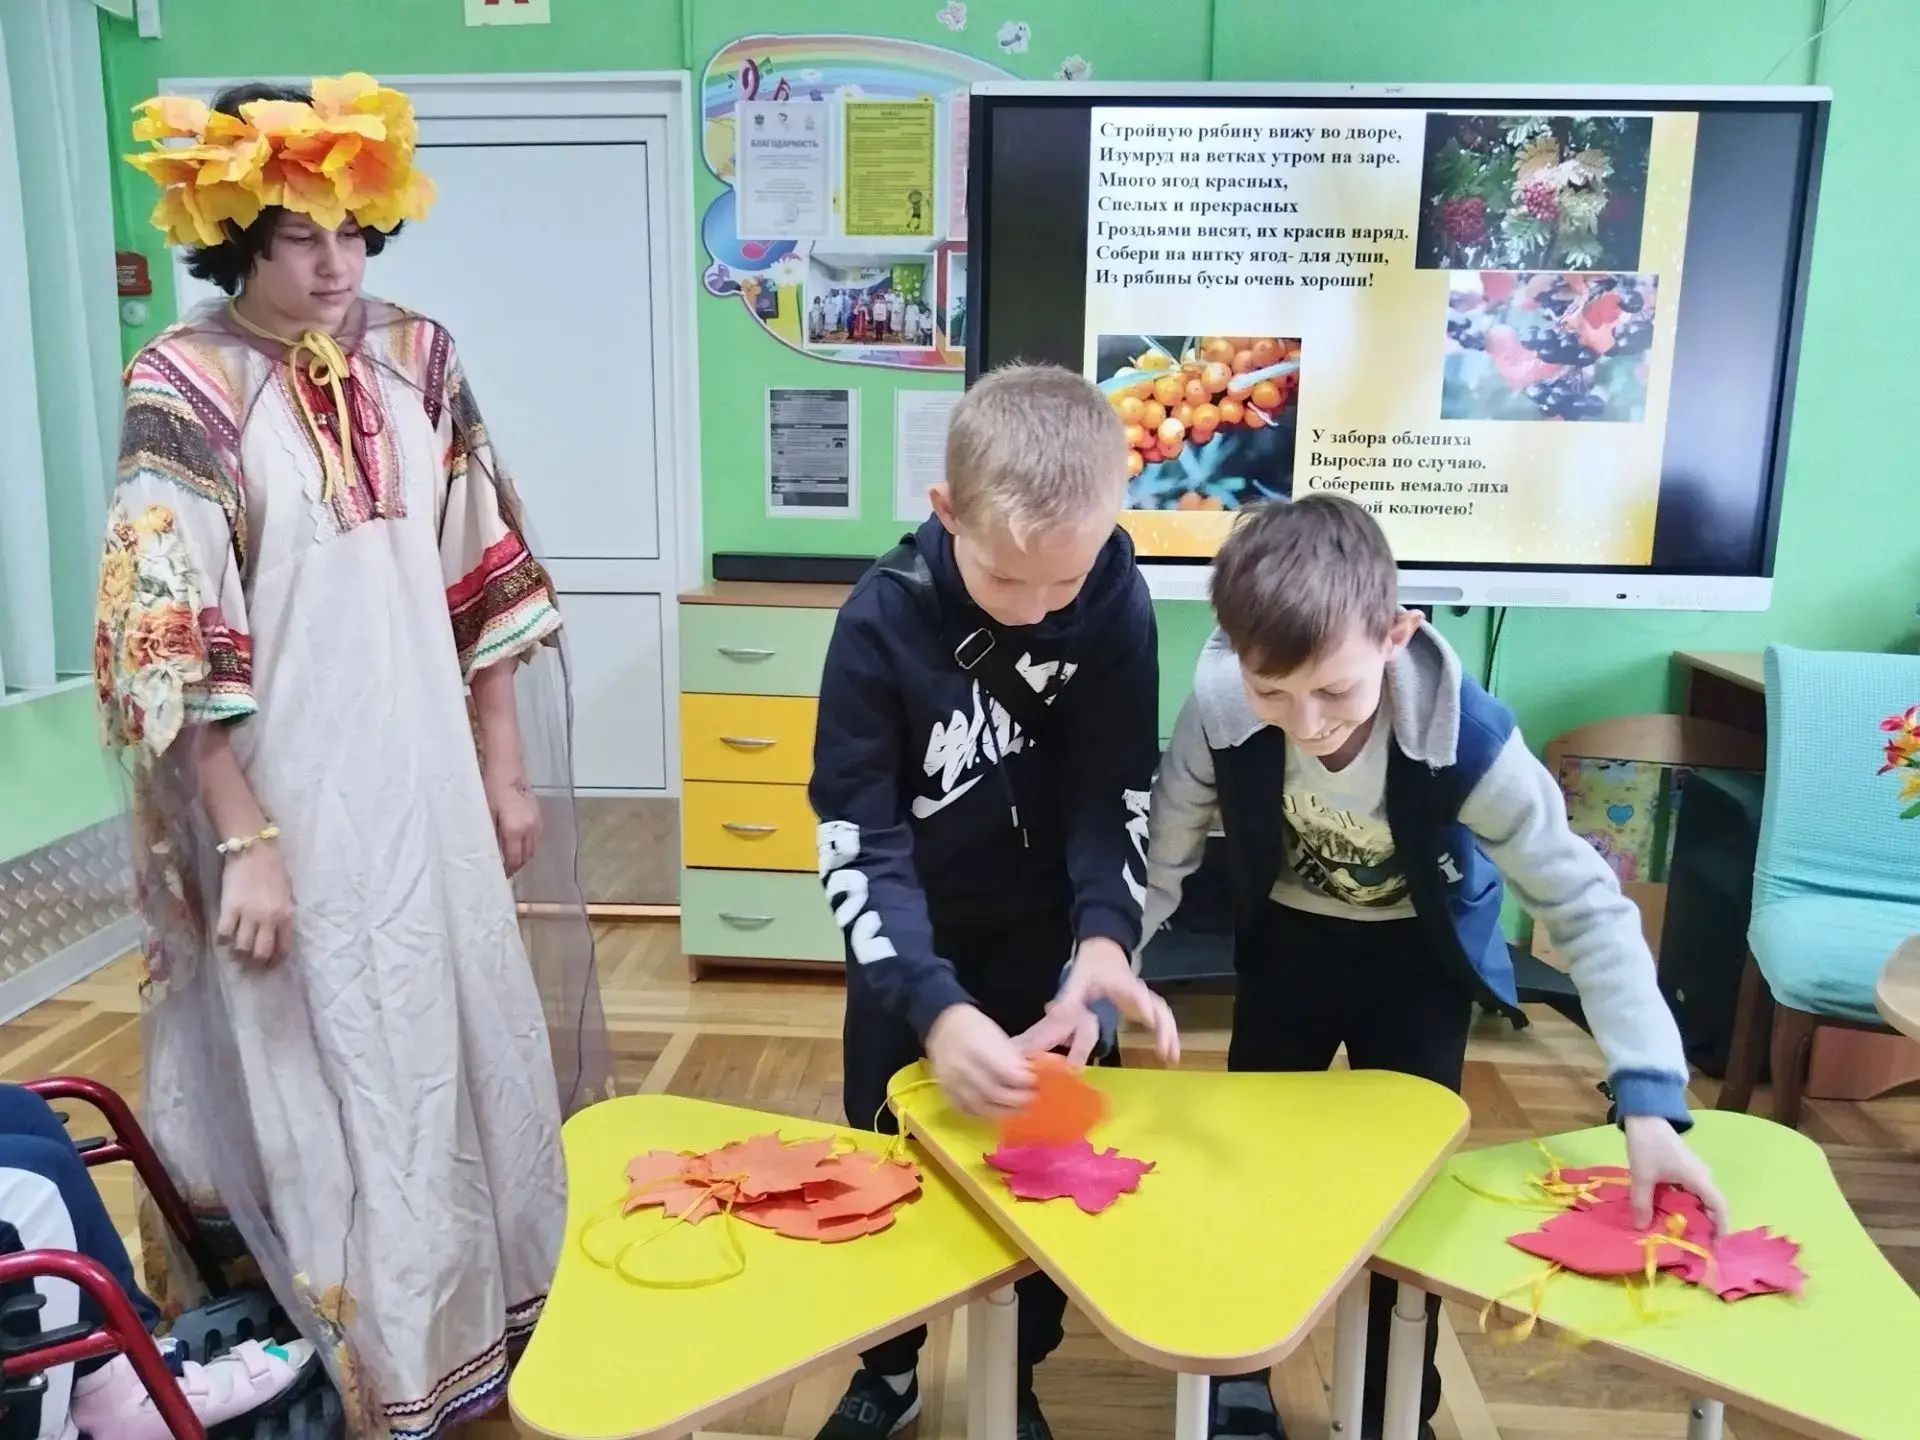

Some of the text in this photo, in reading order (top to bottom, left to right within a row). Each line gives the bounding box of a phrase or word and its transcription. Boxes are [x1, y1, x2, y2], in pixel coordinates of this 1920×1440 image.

[1100, 122, 1402, 144] Стройную рябину вижу во дворе,
[1099, 147, 1400, 169] Изумруд на ветках утром на заре.
[1098, 171, 1288, 193] Много ягод красных,
[1098, 196, 1299, 217] Спелых и прекрасных
[1096, 221, 1409, 244] Гроздьями висят, их красив наряд.
[1096, 245, 1390, 267] Собери на нитку ягод- для души,
[1095, 269, 1374, 292] Из рябины бусы очень хороши!
[1312, 428, 1472, 448] У забора облепиха
[1309, 452, 1487, 473] Выросла по случаю.
[1308, 475, 1509, 496] Соберешь немало лиха
[1389, 501, 1474, 516] колючею!
